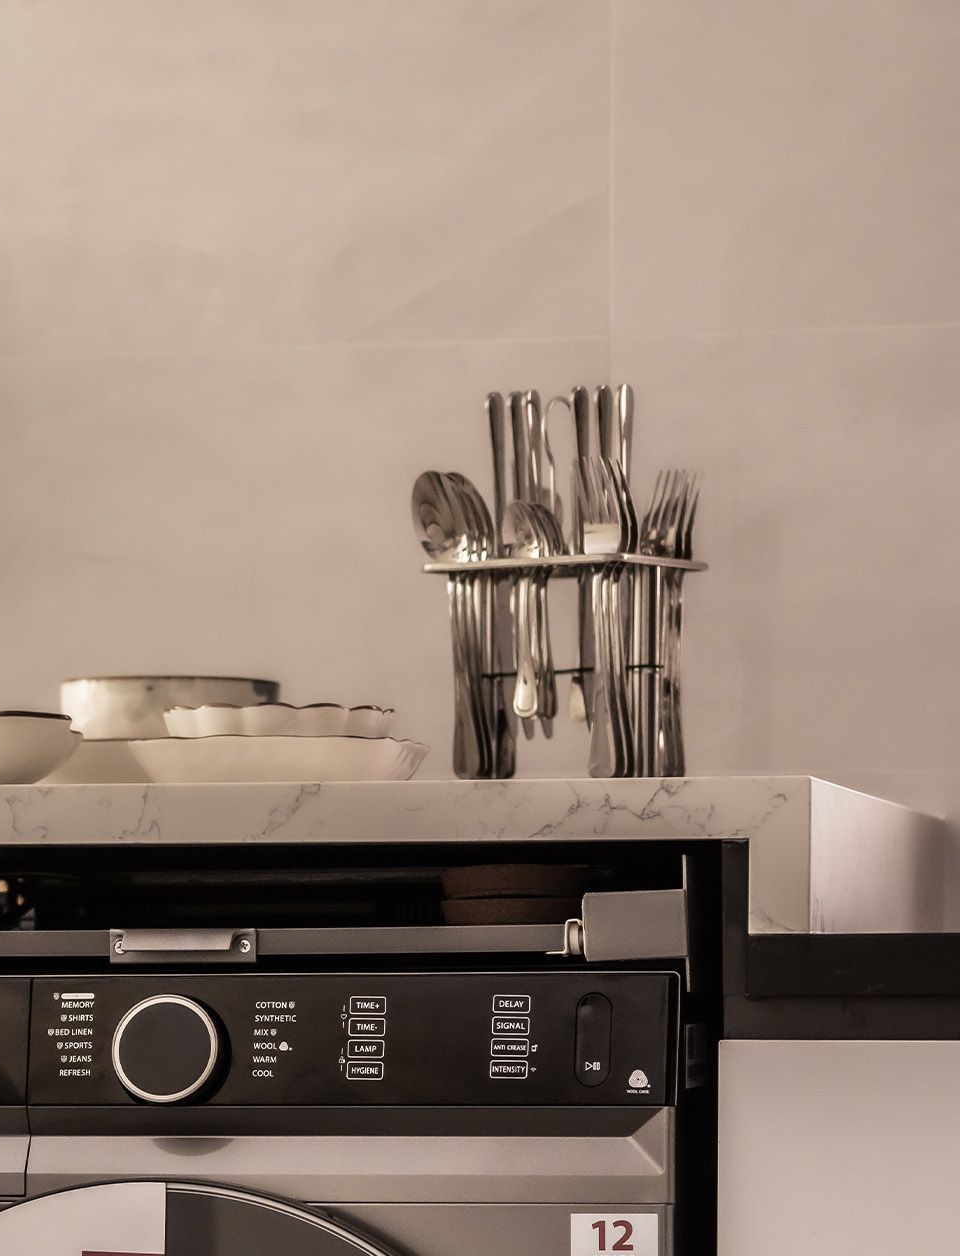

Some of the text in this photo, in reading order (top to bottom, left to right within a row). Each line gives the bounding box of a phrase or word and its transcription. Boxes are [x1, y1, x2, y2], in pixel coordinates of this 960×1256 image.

[61, 1001, 95, 1009] MEMORY
[255, 1001, 287, 1009] COTTON
[499, 1000, 524, 1008] DELAY
[68, 1014, 94, 1022] SHIRTS
[356, 1023, 378, 1031] TIME-
[496, 1022, 526, 1030] SIGNAL
[55, 1028, 93, 1036] BED LINEN
[253, 1042, 277, 1050] WOOL
[351, 1067, 379, 1075] HYGIENE
[591, 1219, 634, 1251] 12
